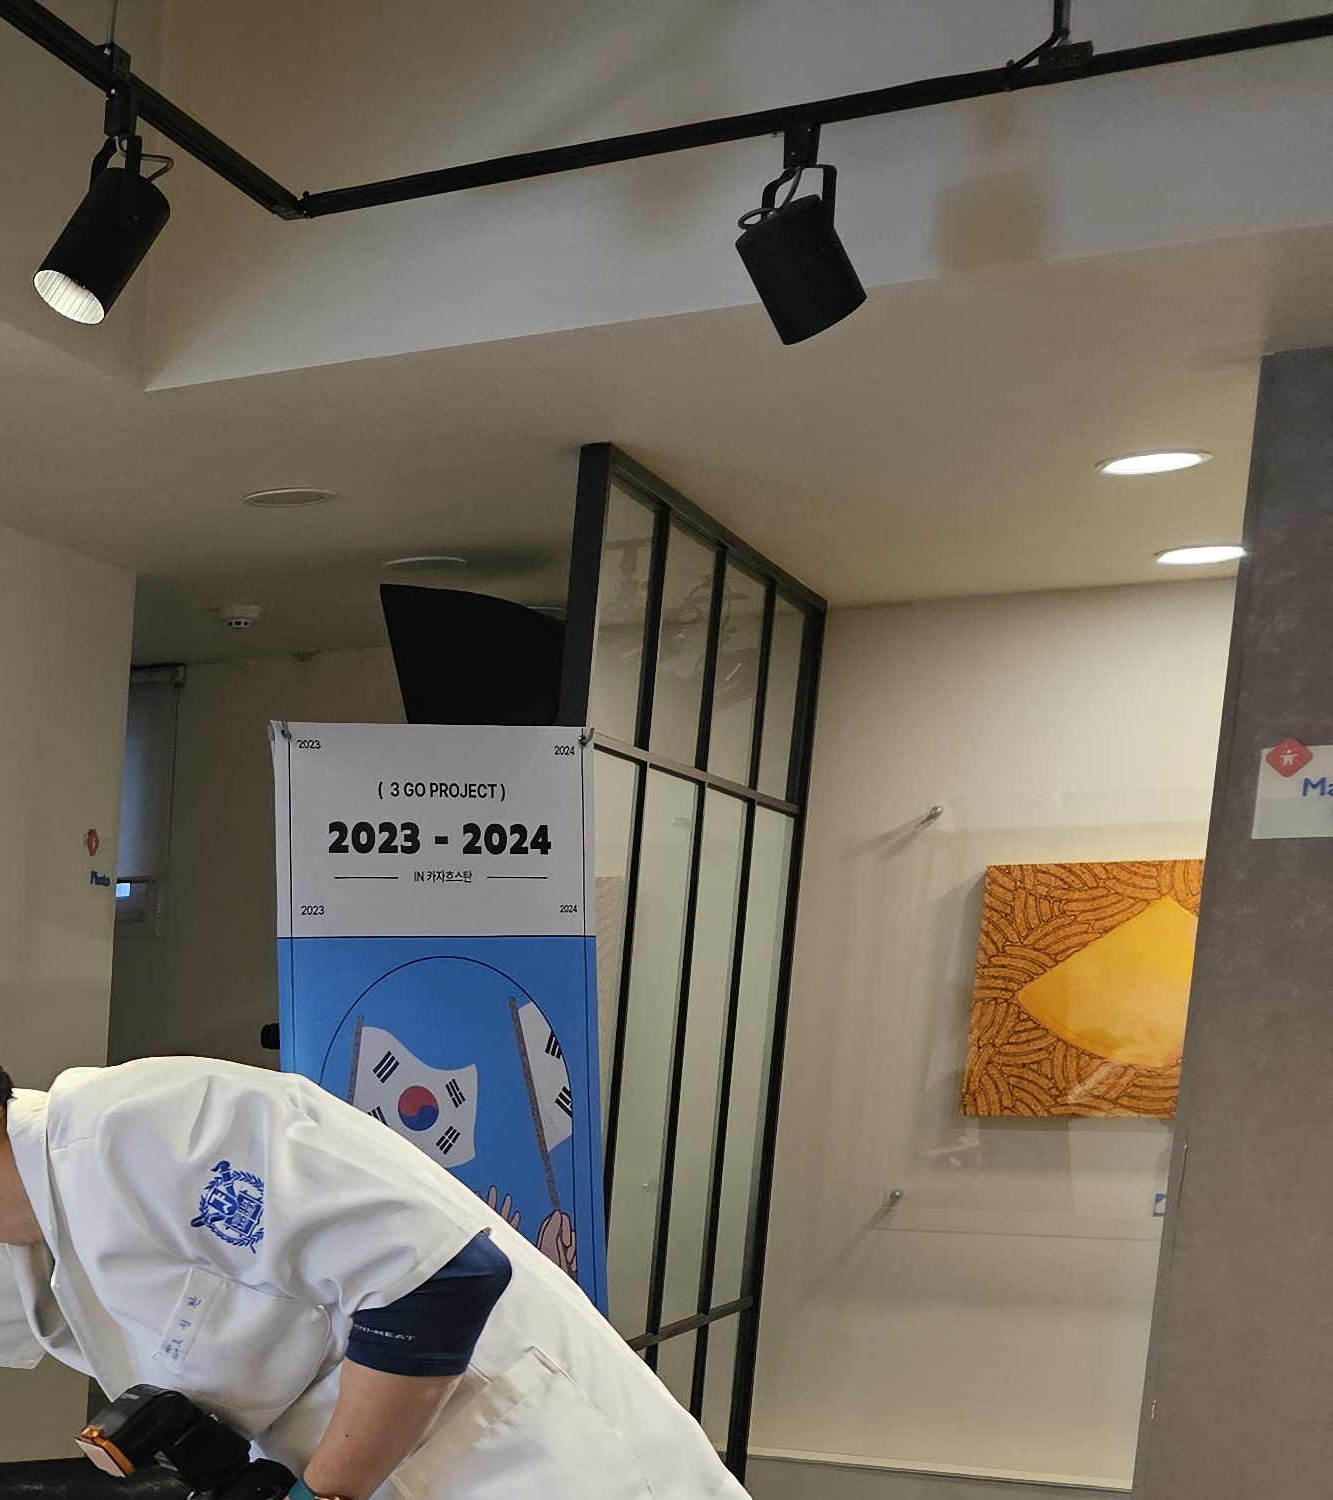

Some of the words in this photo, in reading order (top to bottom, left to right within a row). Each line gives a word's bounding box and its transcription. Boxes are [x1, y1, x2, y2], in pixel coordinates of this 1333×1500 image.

[297, 739, 321, 750] 2023
[554, 746, 575, 756] 2024
[404, 782, 426, 797] GO
[328, 821, 421, 854] 2023
[462, 823, 552, 855] 2024
[414, 871, 425, 882] IN
[426, 870, 473, 883] 카자흐스탄
[301, 905, 325, 916] 2023
[559, 904, 578, 914] 2024
